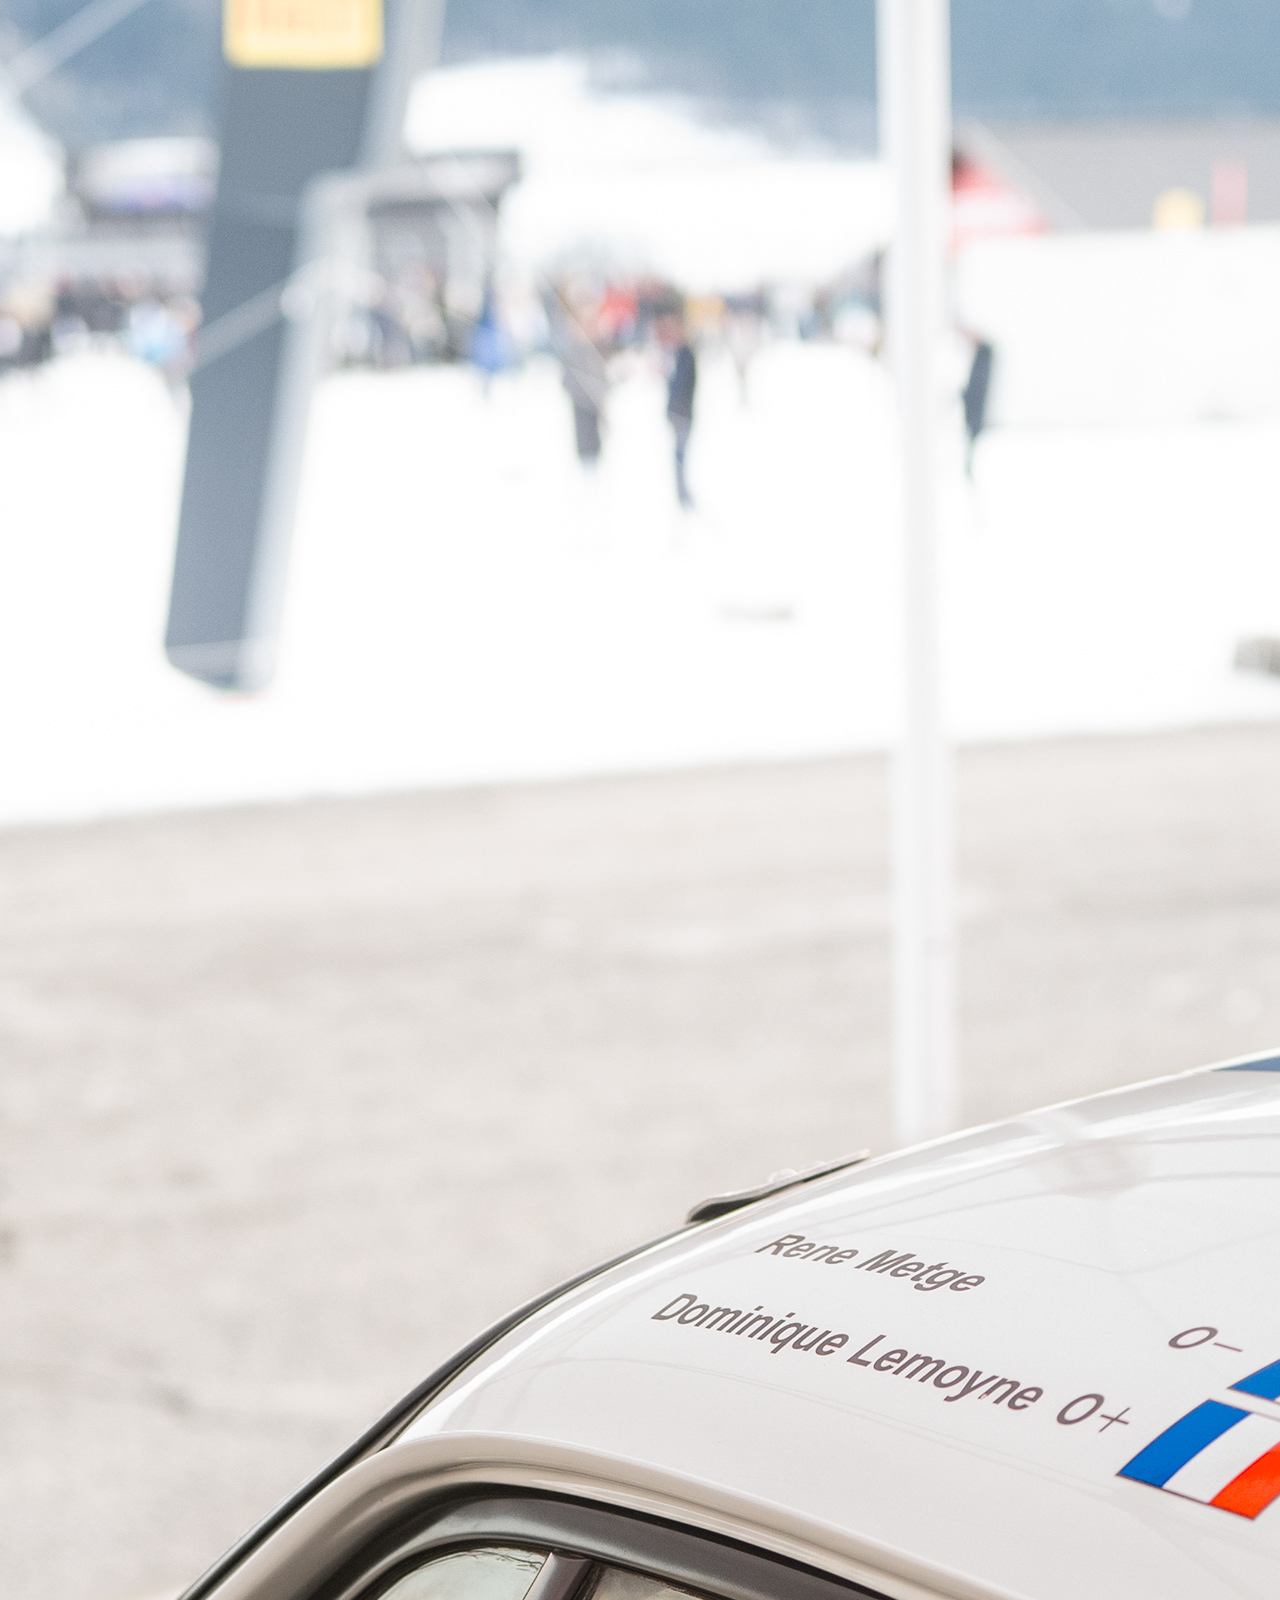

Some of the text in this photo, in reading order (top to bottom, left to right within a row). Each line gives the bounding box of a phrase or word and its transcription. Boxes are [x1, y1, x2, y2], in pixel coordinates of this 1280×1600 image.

[755, 1233, 859, 1266] Rene
[854, 1248, 986, 1293] Metge
[650, 1293, 850, 1356] Dominique
[846, 1333, 1045, 1412] Lemoyne
